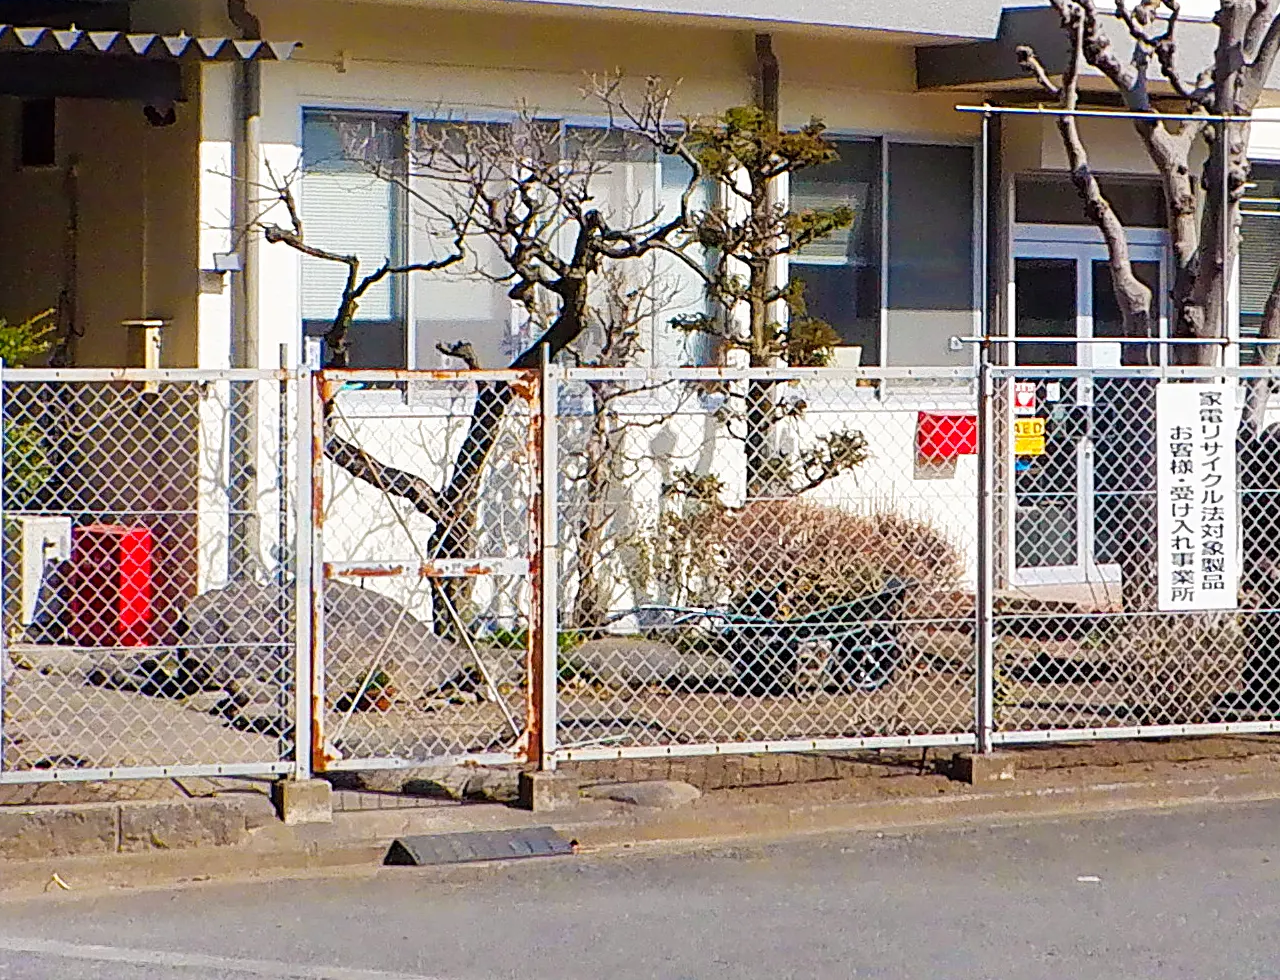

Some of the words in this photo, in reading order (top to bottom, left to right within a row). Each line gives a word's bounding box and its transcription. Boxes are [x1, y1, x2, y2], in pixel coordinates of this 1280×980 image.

[1199, 391, 1225, 590] 家電リサイクル法対象製品
